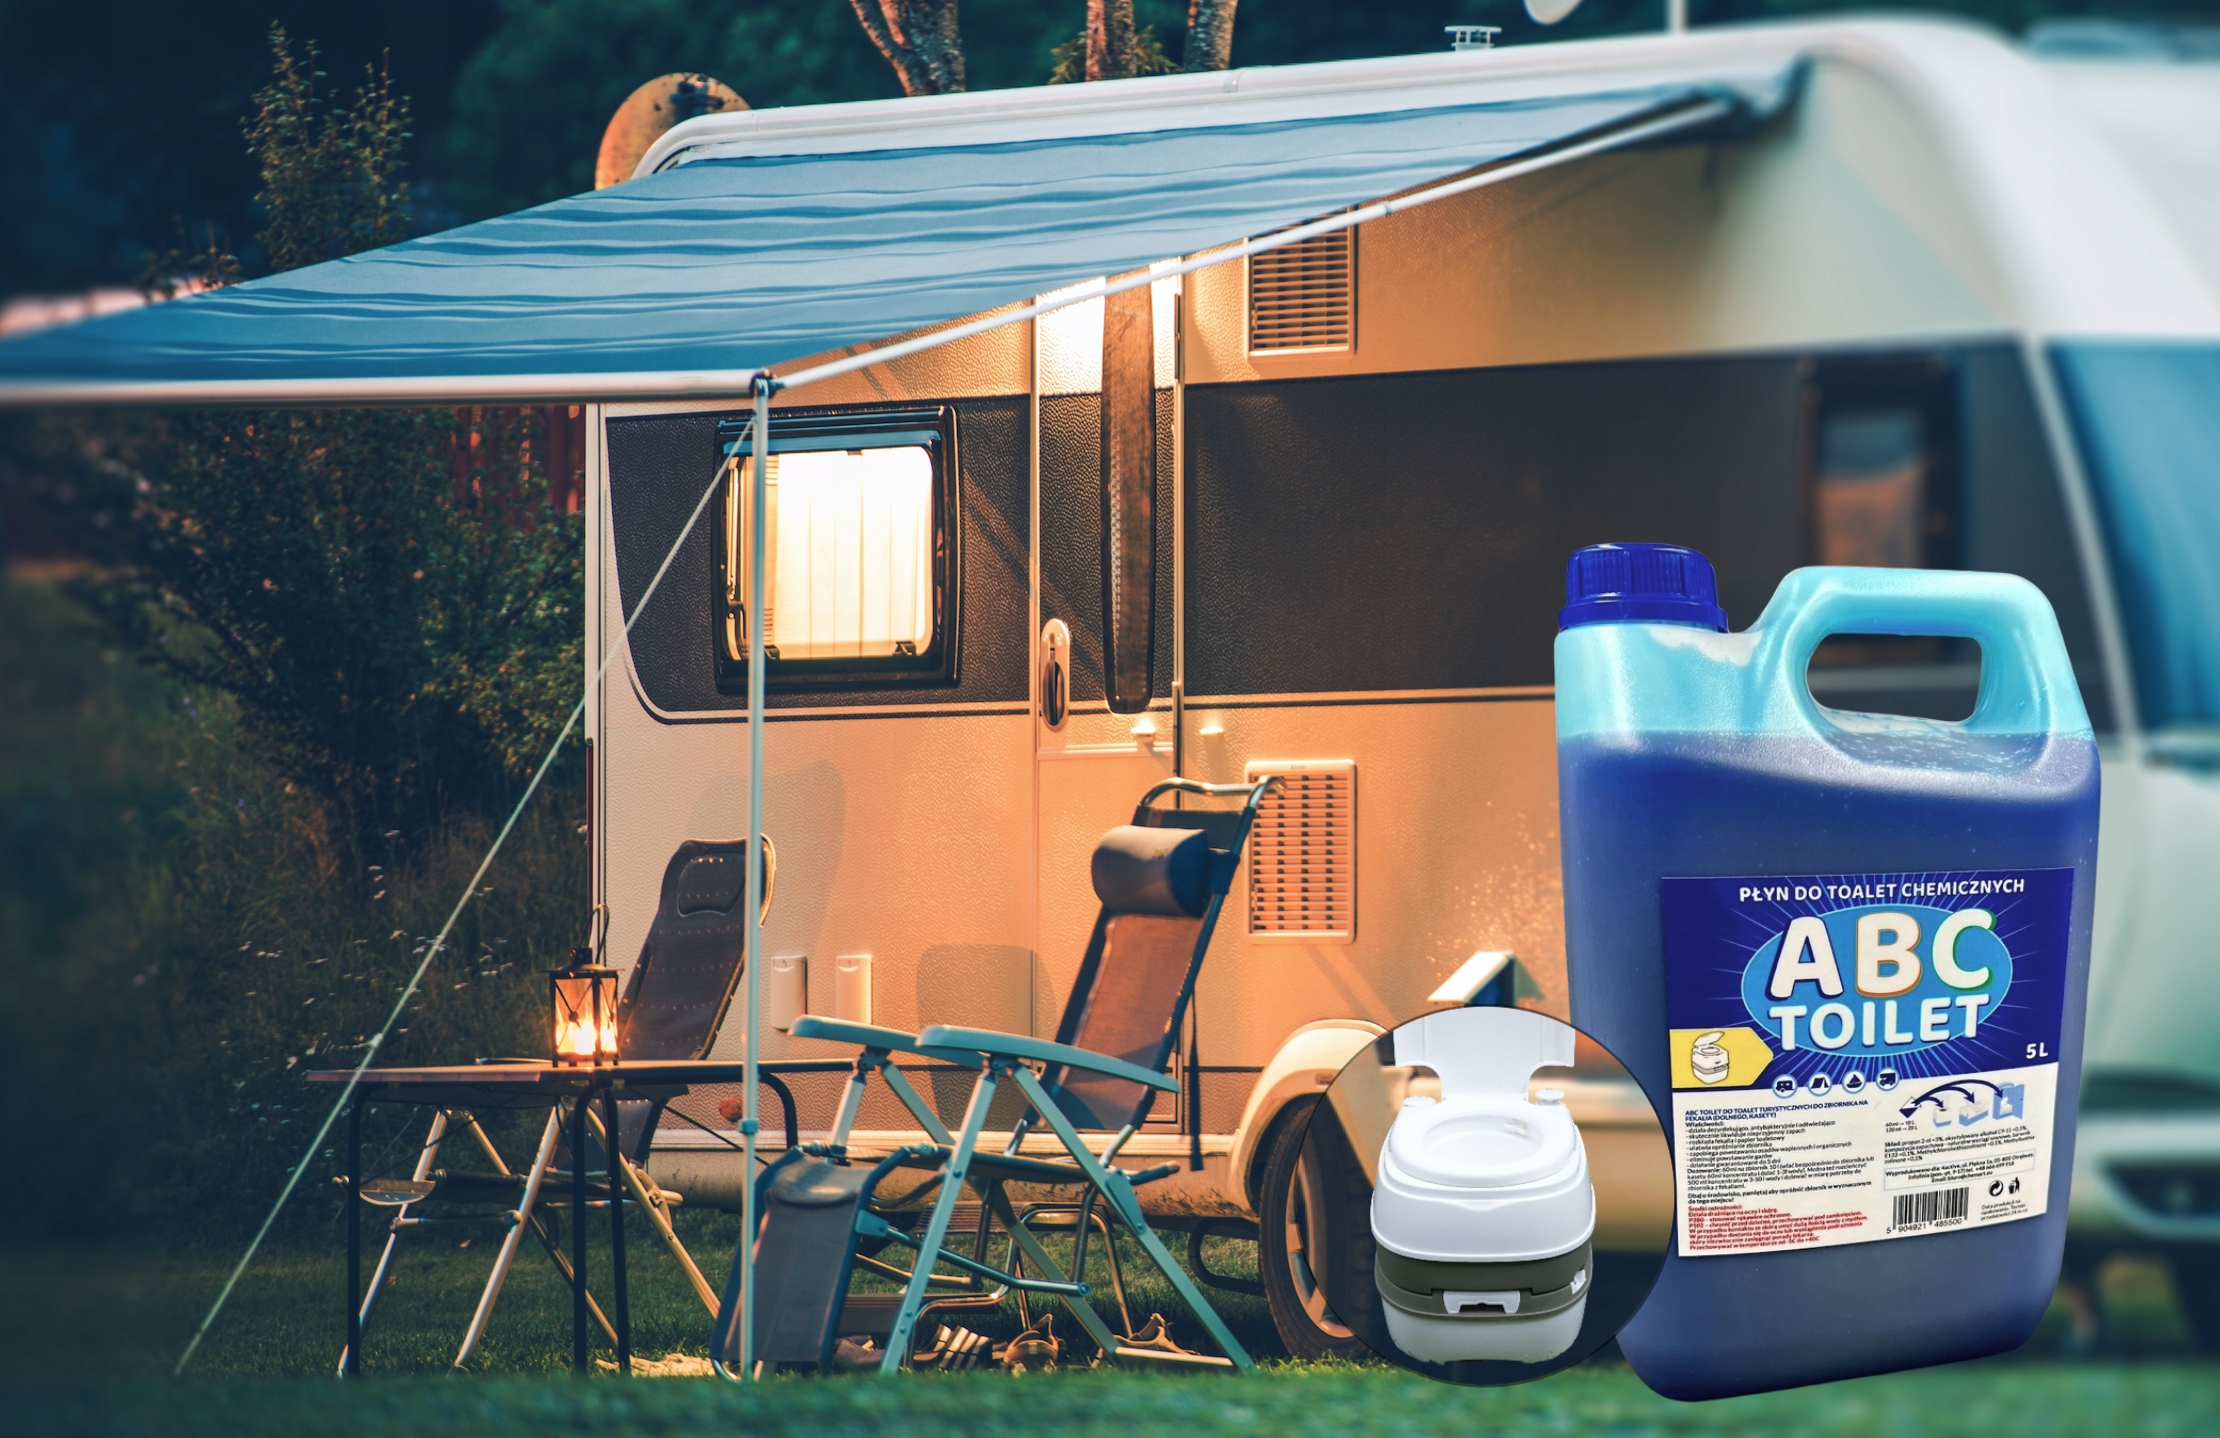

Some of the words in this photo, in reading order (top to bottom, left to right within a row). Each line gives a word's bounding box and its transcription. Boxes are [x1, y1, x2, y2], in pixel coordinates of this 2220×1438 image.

[1740, 886, 1789, 902] PŁYN
[1794, 885, 1822, 900] DO
[1827, 883, 1897, 899] TOALET
[1902, 878, 2025, 898] CHEMICZNYCH
[1765, 908, 1997, 999] ABC
[1768, 993, 1990, 1051] TOILET
[1758, 1104, 1812, 1112] TURYSTYCZNYCH
[1898, 1223, 1926, 1232] 904921
[1934, 1218, 1962, 1228] 485500
